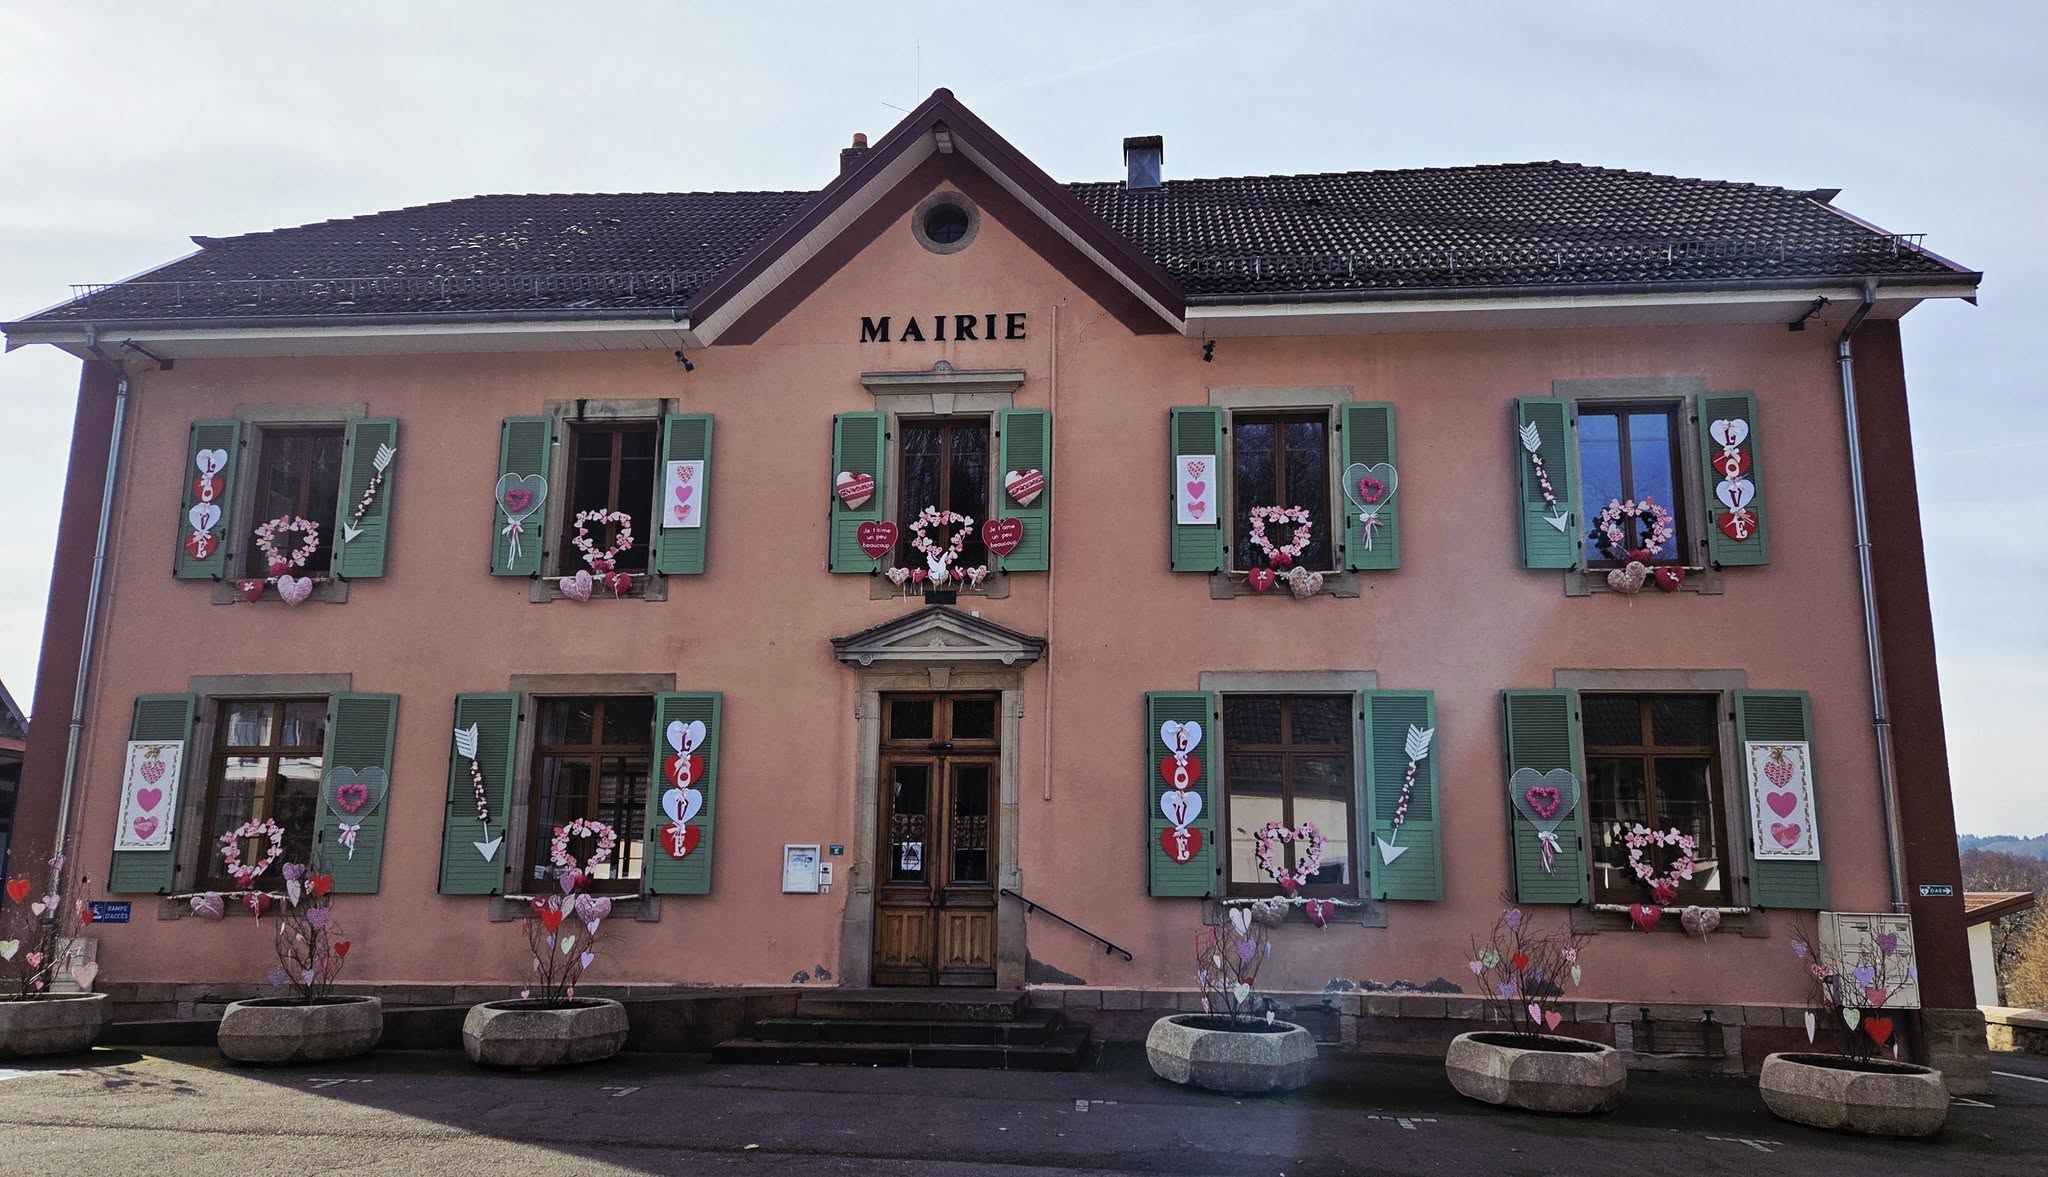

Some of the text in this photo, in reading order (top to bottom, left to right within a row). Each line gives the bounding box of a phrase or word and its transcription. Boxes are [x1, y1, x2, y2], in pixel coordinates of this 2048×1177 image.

[859, 313, 1027, 343] MAIRIE
[862, 541, 890, 550] beaucoup
[990, 540, 1017, 549] beaucoup
